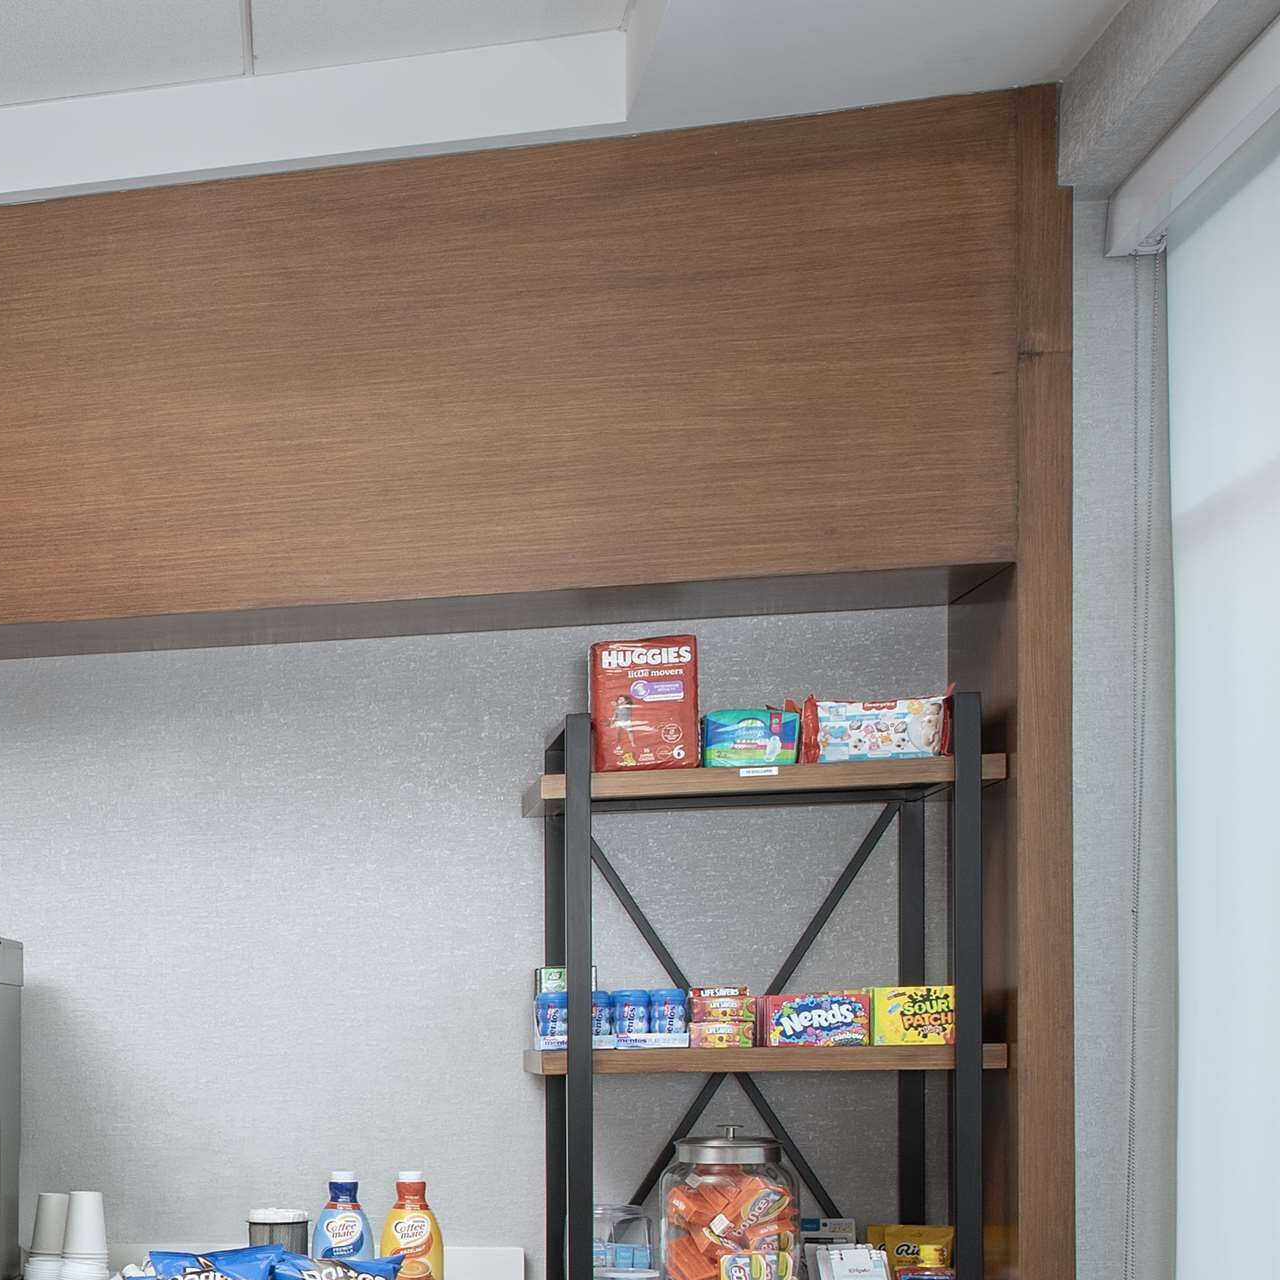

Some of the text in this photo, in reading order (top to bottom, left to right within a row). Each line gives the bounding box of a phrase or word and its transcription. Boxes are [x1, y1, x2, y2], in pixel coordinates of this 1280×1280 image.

[601, 645, 692, 669] HUGGIES
[628, 668, 684, 679] little movers
[672, 744, 686, 760] 6
[700, 988, 739, 997] LIFE SAVERS
[903, 999, 950, 1016] SOUR
[903, 1014, 953, 1027] PATCH
[733, 1199, 769, 1237] bounce
[326, 1220, 357, 1234] Coffee
[394, 1220, 426, 1234] Coffee
[332, 1230, 355, 1239] mate
[400, 1230, 424, 1240] mate
